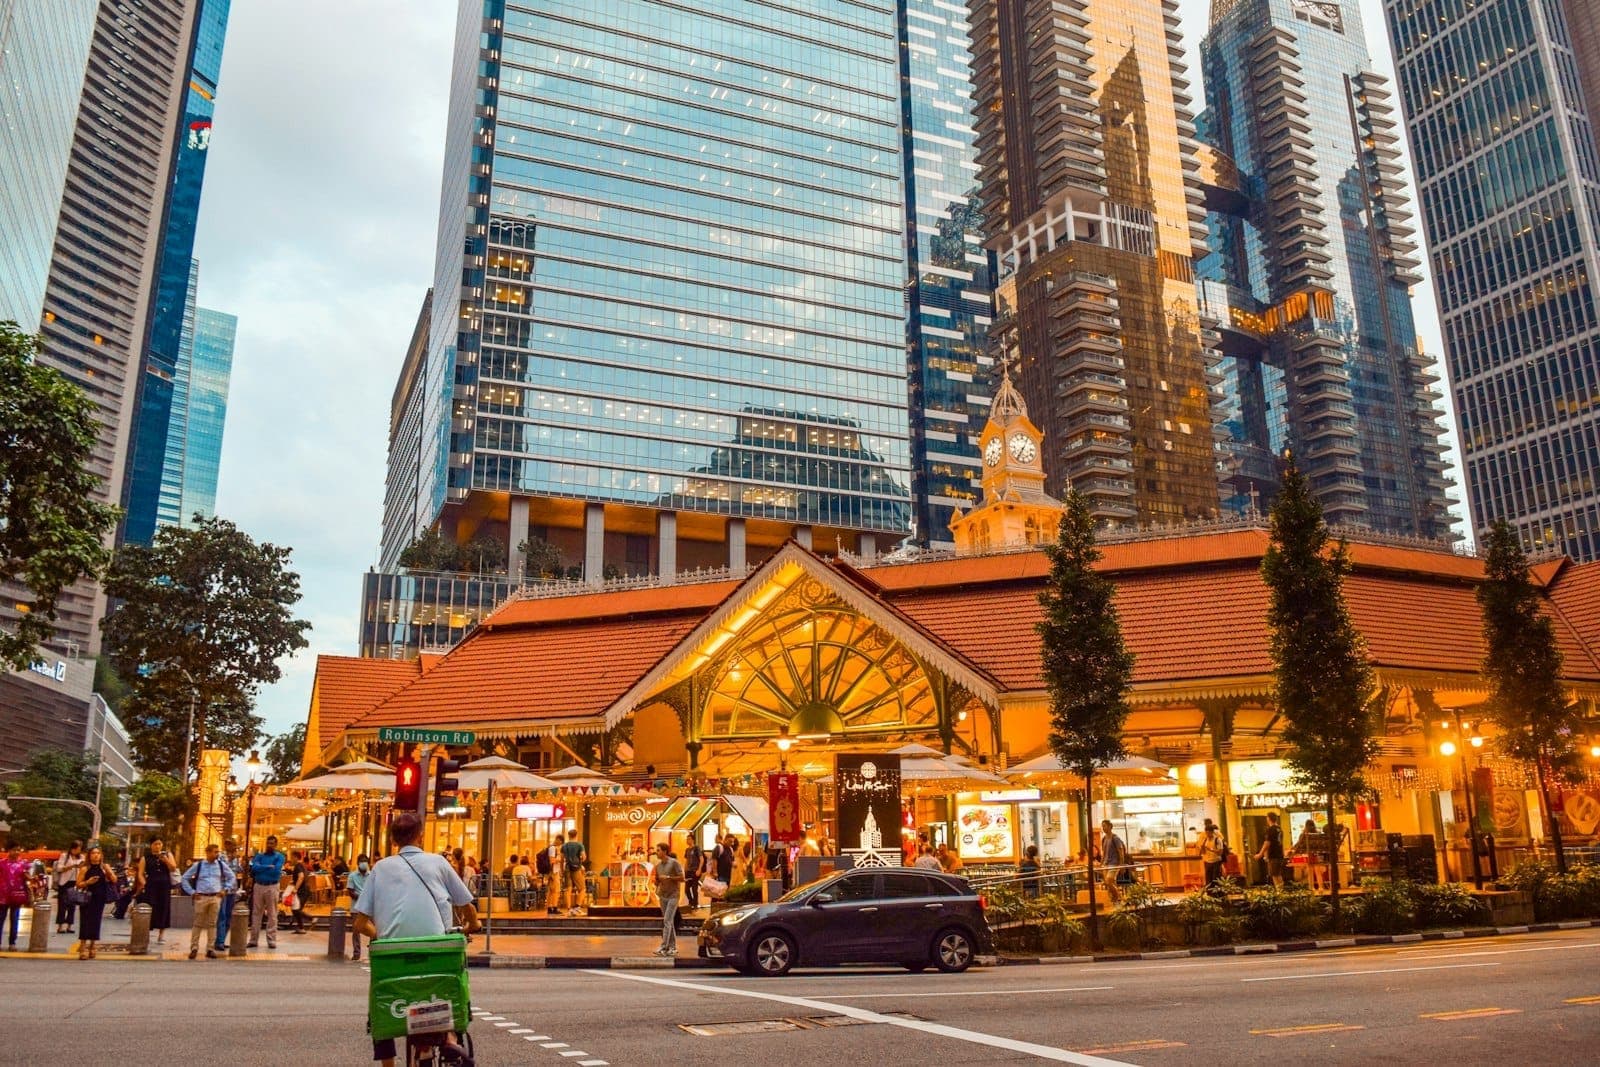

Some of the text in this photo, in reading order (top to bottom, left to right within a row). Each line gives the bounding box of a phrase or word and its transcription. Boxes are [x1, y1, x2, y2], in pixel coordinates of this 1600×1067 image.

[385, 729, 470, 744] Robinson Rd
[1253, 794, 1295, 808] Mango
